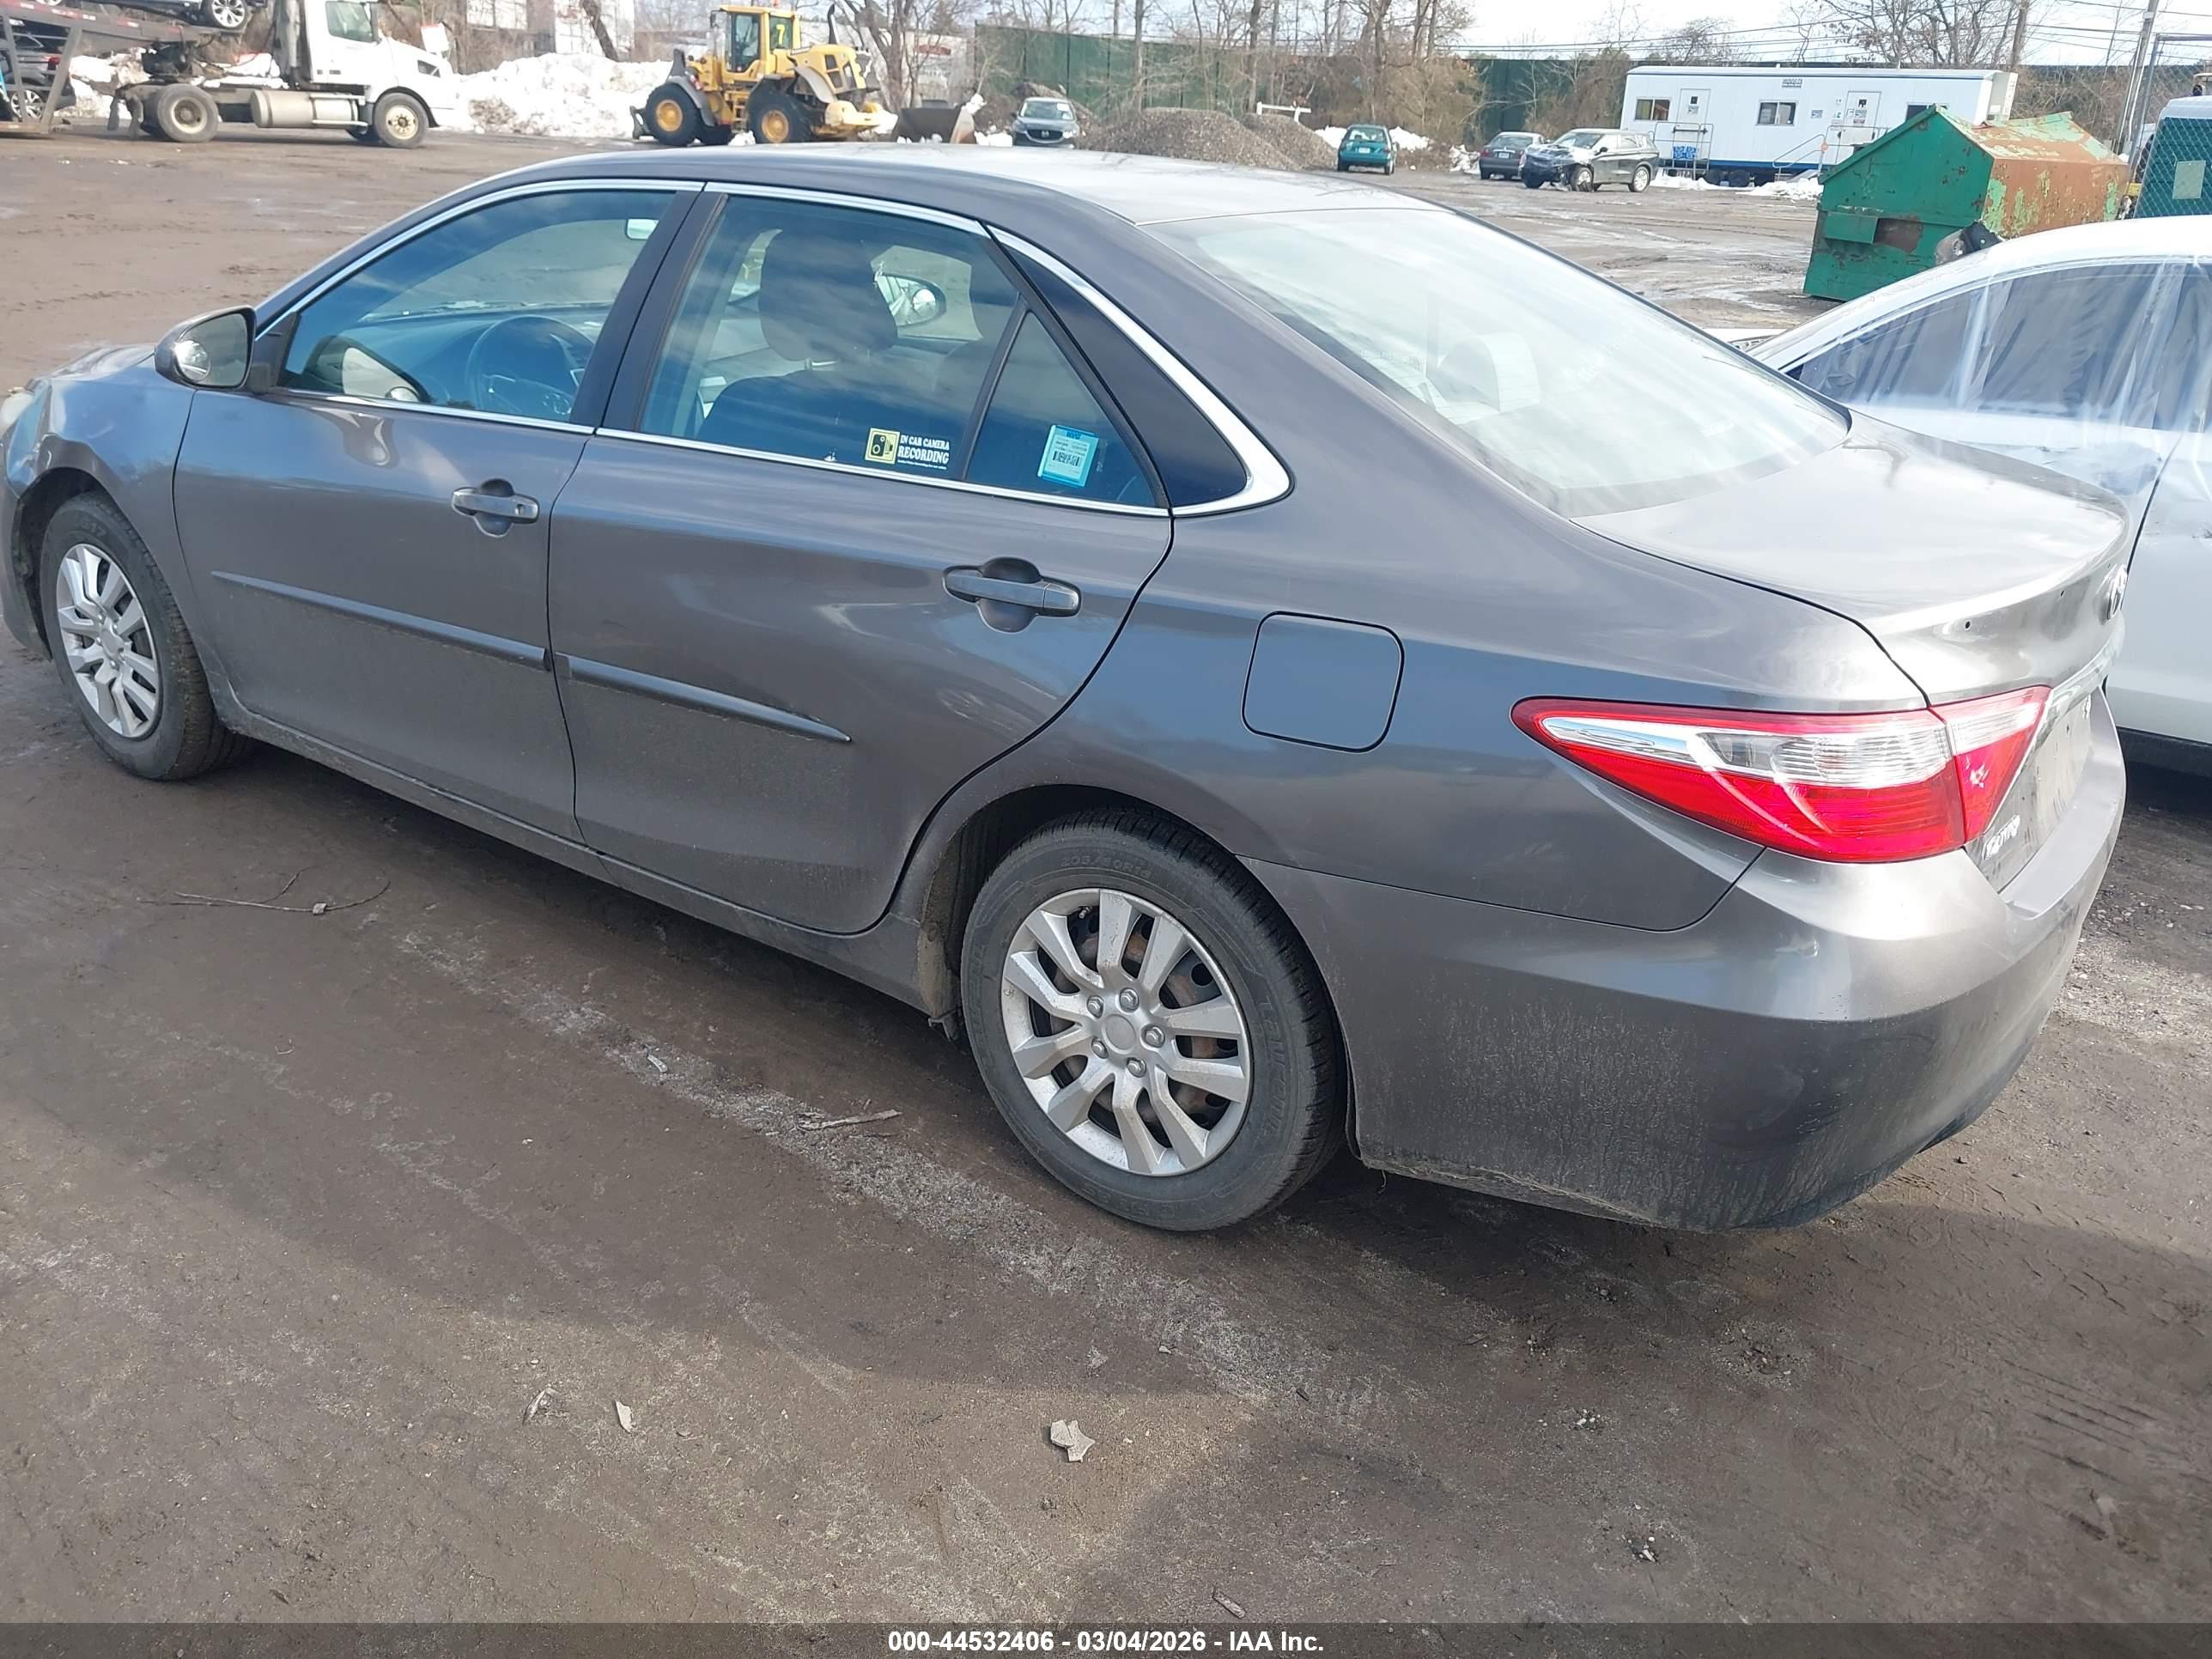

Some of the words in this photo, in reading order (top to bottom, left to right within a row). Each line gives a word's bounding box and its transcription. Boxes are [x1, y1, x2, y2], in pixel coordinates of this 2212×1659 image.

[775, 23, 786, 45] 7
[900, 434, 908, 444] IN
[908, 435, 922, 447] CAR
[922, 437, 951, 451] CAMERA
[897, 445, 950, 465] RECORDING
